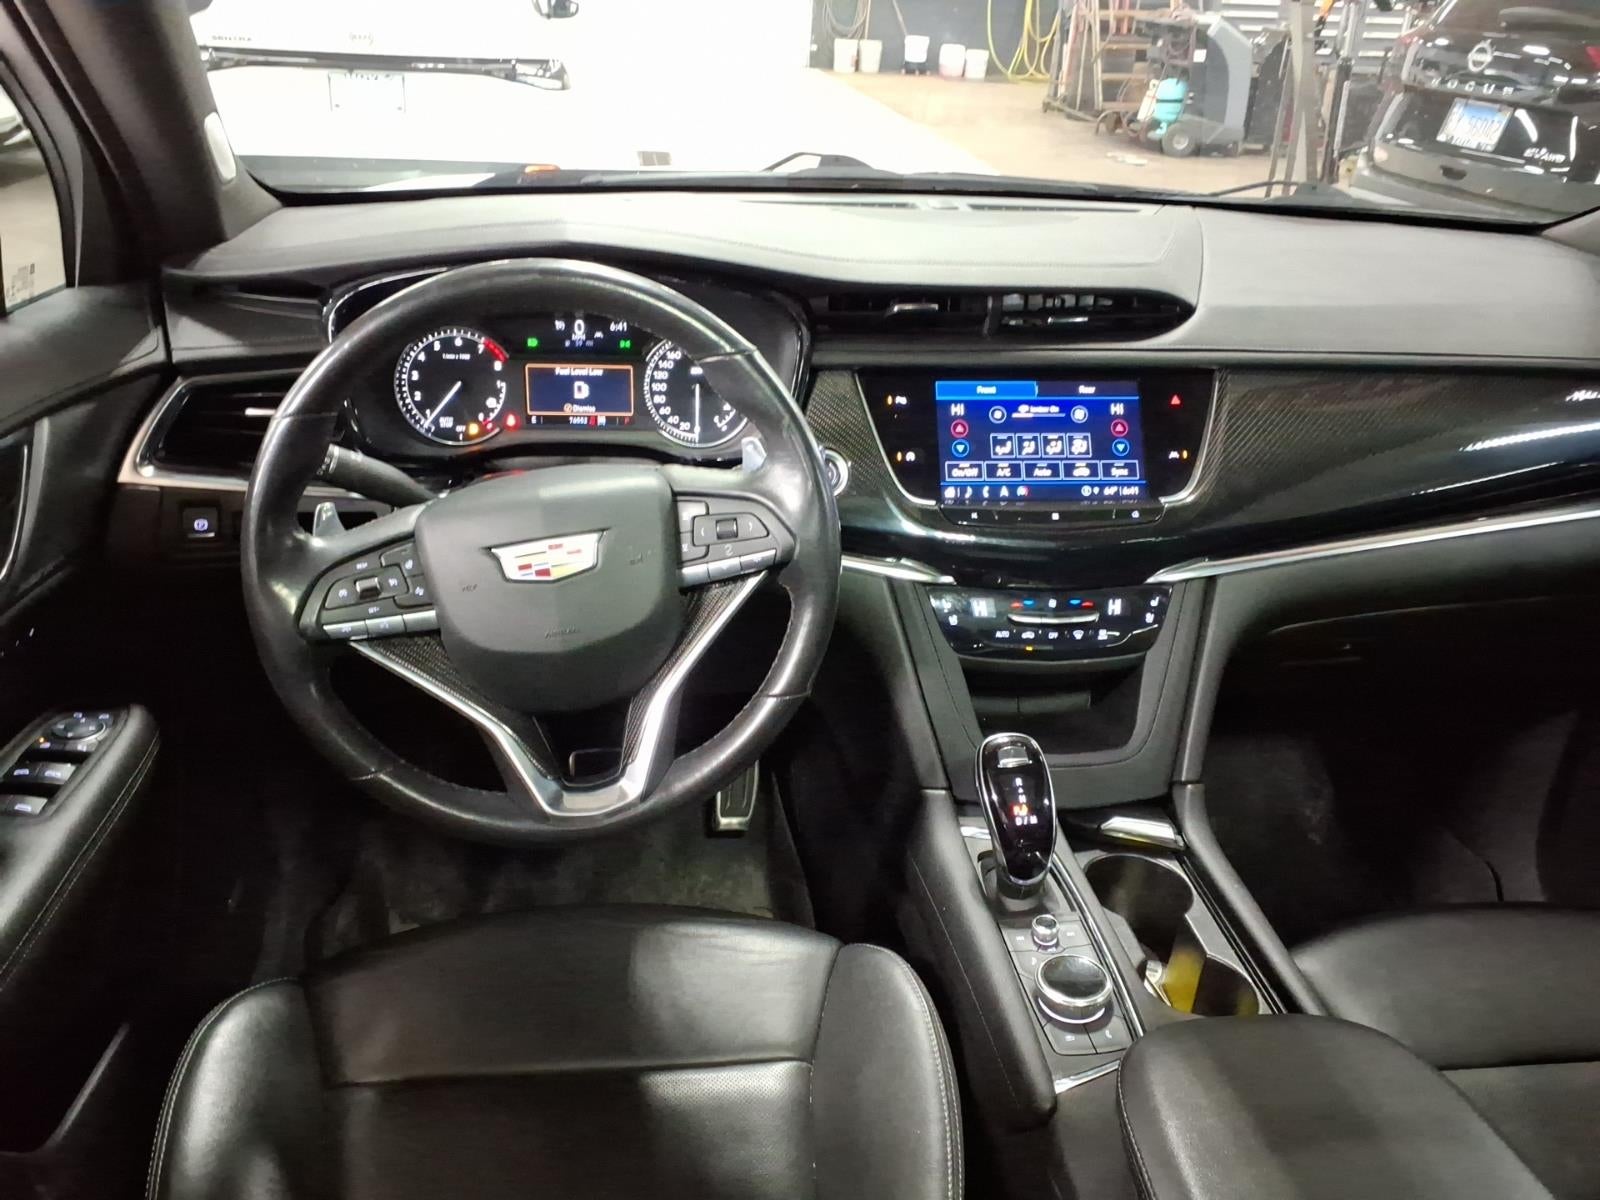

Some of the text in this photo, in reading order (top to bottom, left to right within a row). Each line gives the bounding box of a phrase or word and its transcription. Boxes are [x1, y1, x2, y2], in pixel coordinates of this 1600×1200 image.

[609, 321, 628, 332] 6:41
[666, 350, 682, 360] 160
[658, 359, 674, 369] 140
[651, 382, 668, 392] 100
[658, 405, 672, 415] 60
[950, 403, 965, 416] HI
[1110, 402, 1124, 415] HI
[666, 415, 680, 425] 40
[679, 421, 691, 431] 20
[996, 468, 1011, 477] A/C
[1107, 598, 1122, 615] HI
